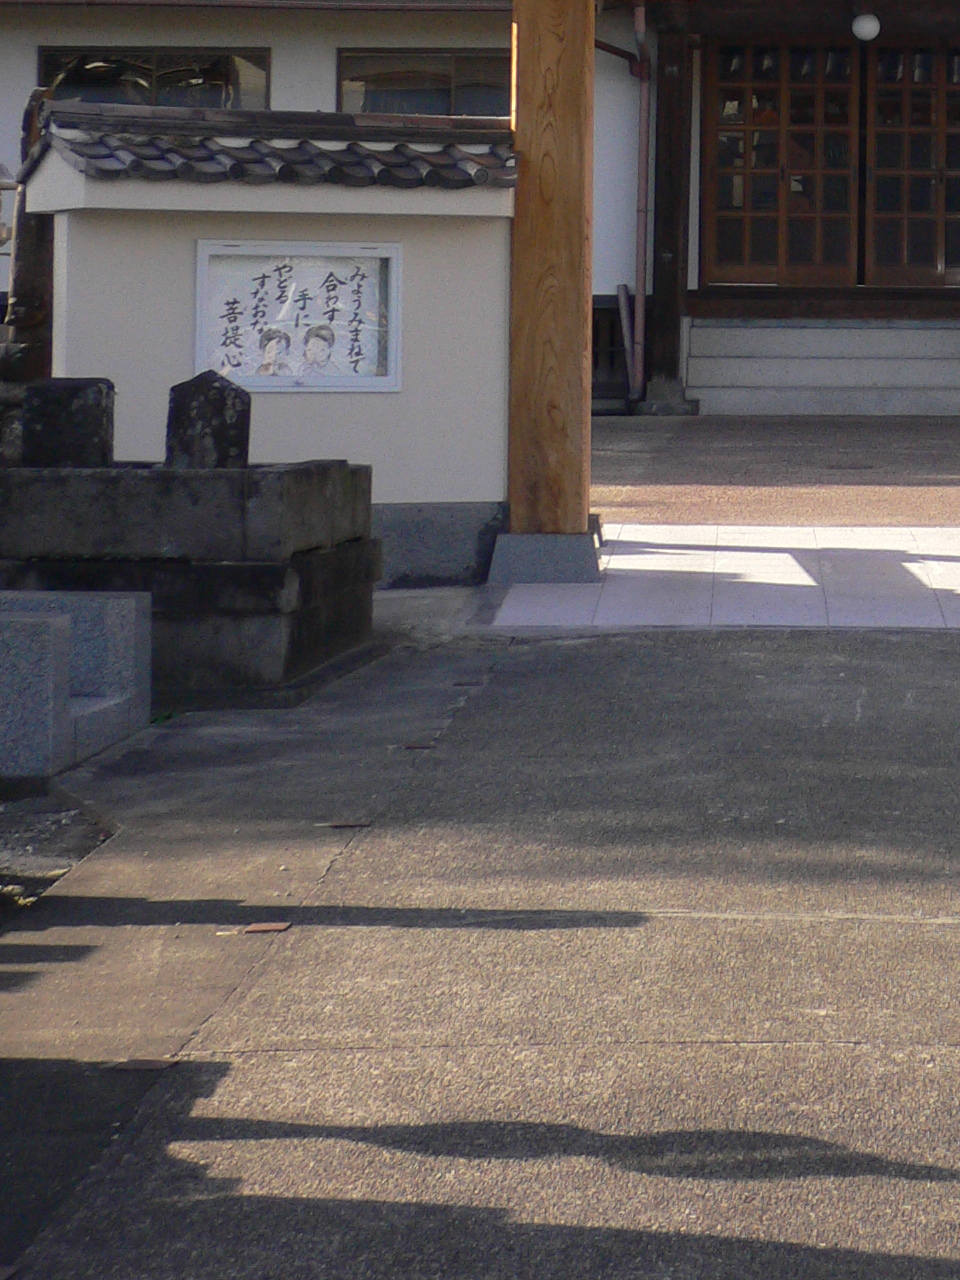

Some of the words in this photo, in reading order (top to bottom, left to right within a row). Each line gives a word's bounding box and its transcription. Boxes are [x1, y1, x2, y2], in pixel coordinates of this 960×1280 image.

[251, 273, 271, 334] すなおな
[273, 264, 294, 305] やどる
[294, 288, 314, 328] 手に
[319, 271, 348, 324] 合わす
[219, 298, 245, 368] 菩提心
[347, 265, 368, 374] みようみまねて
